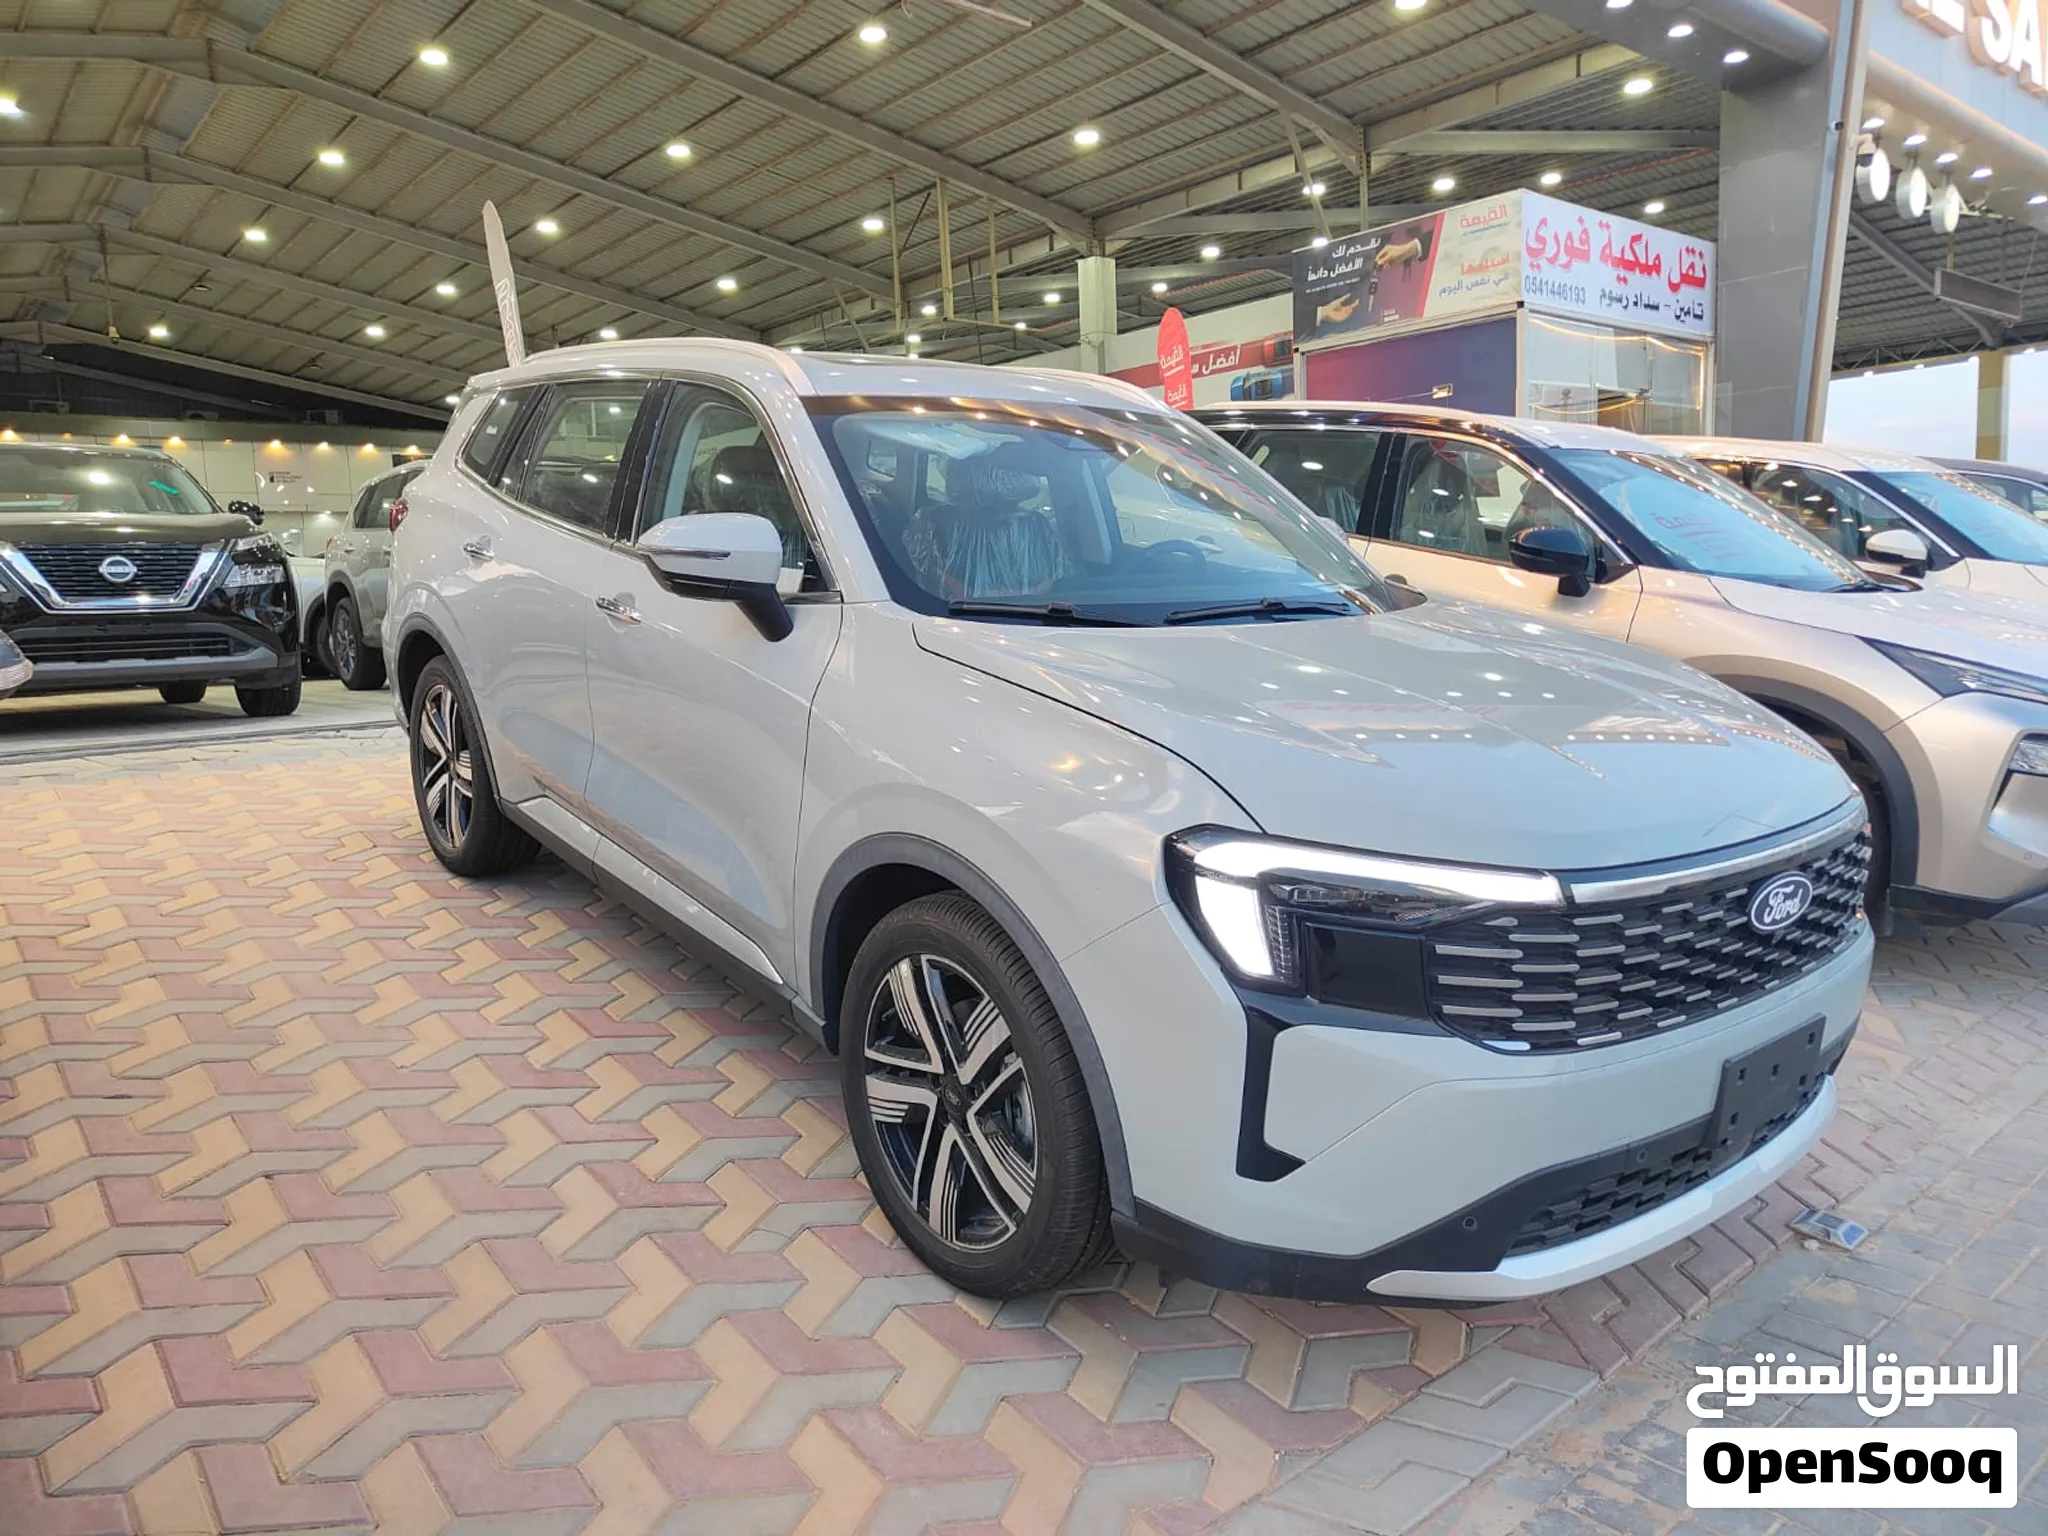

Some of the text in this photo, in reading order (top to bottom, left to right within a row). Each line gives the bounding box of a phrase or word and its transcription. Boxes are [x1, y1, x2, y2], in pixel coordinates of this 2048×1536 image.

[1525, 216, 1708, 295] نقل ملكية فوري
[1524, 275, 1586, 306] 0541446193
[1599, 287, 1630, 311] رسوم
[1632, 295, 1660, 311] سداد
[1202, 344, 1241, 375] أفضل
[1763, 884, 1803, 924] Ford
